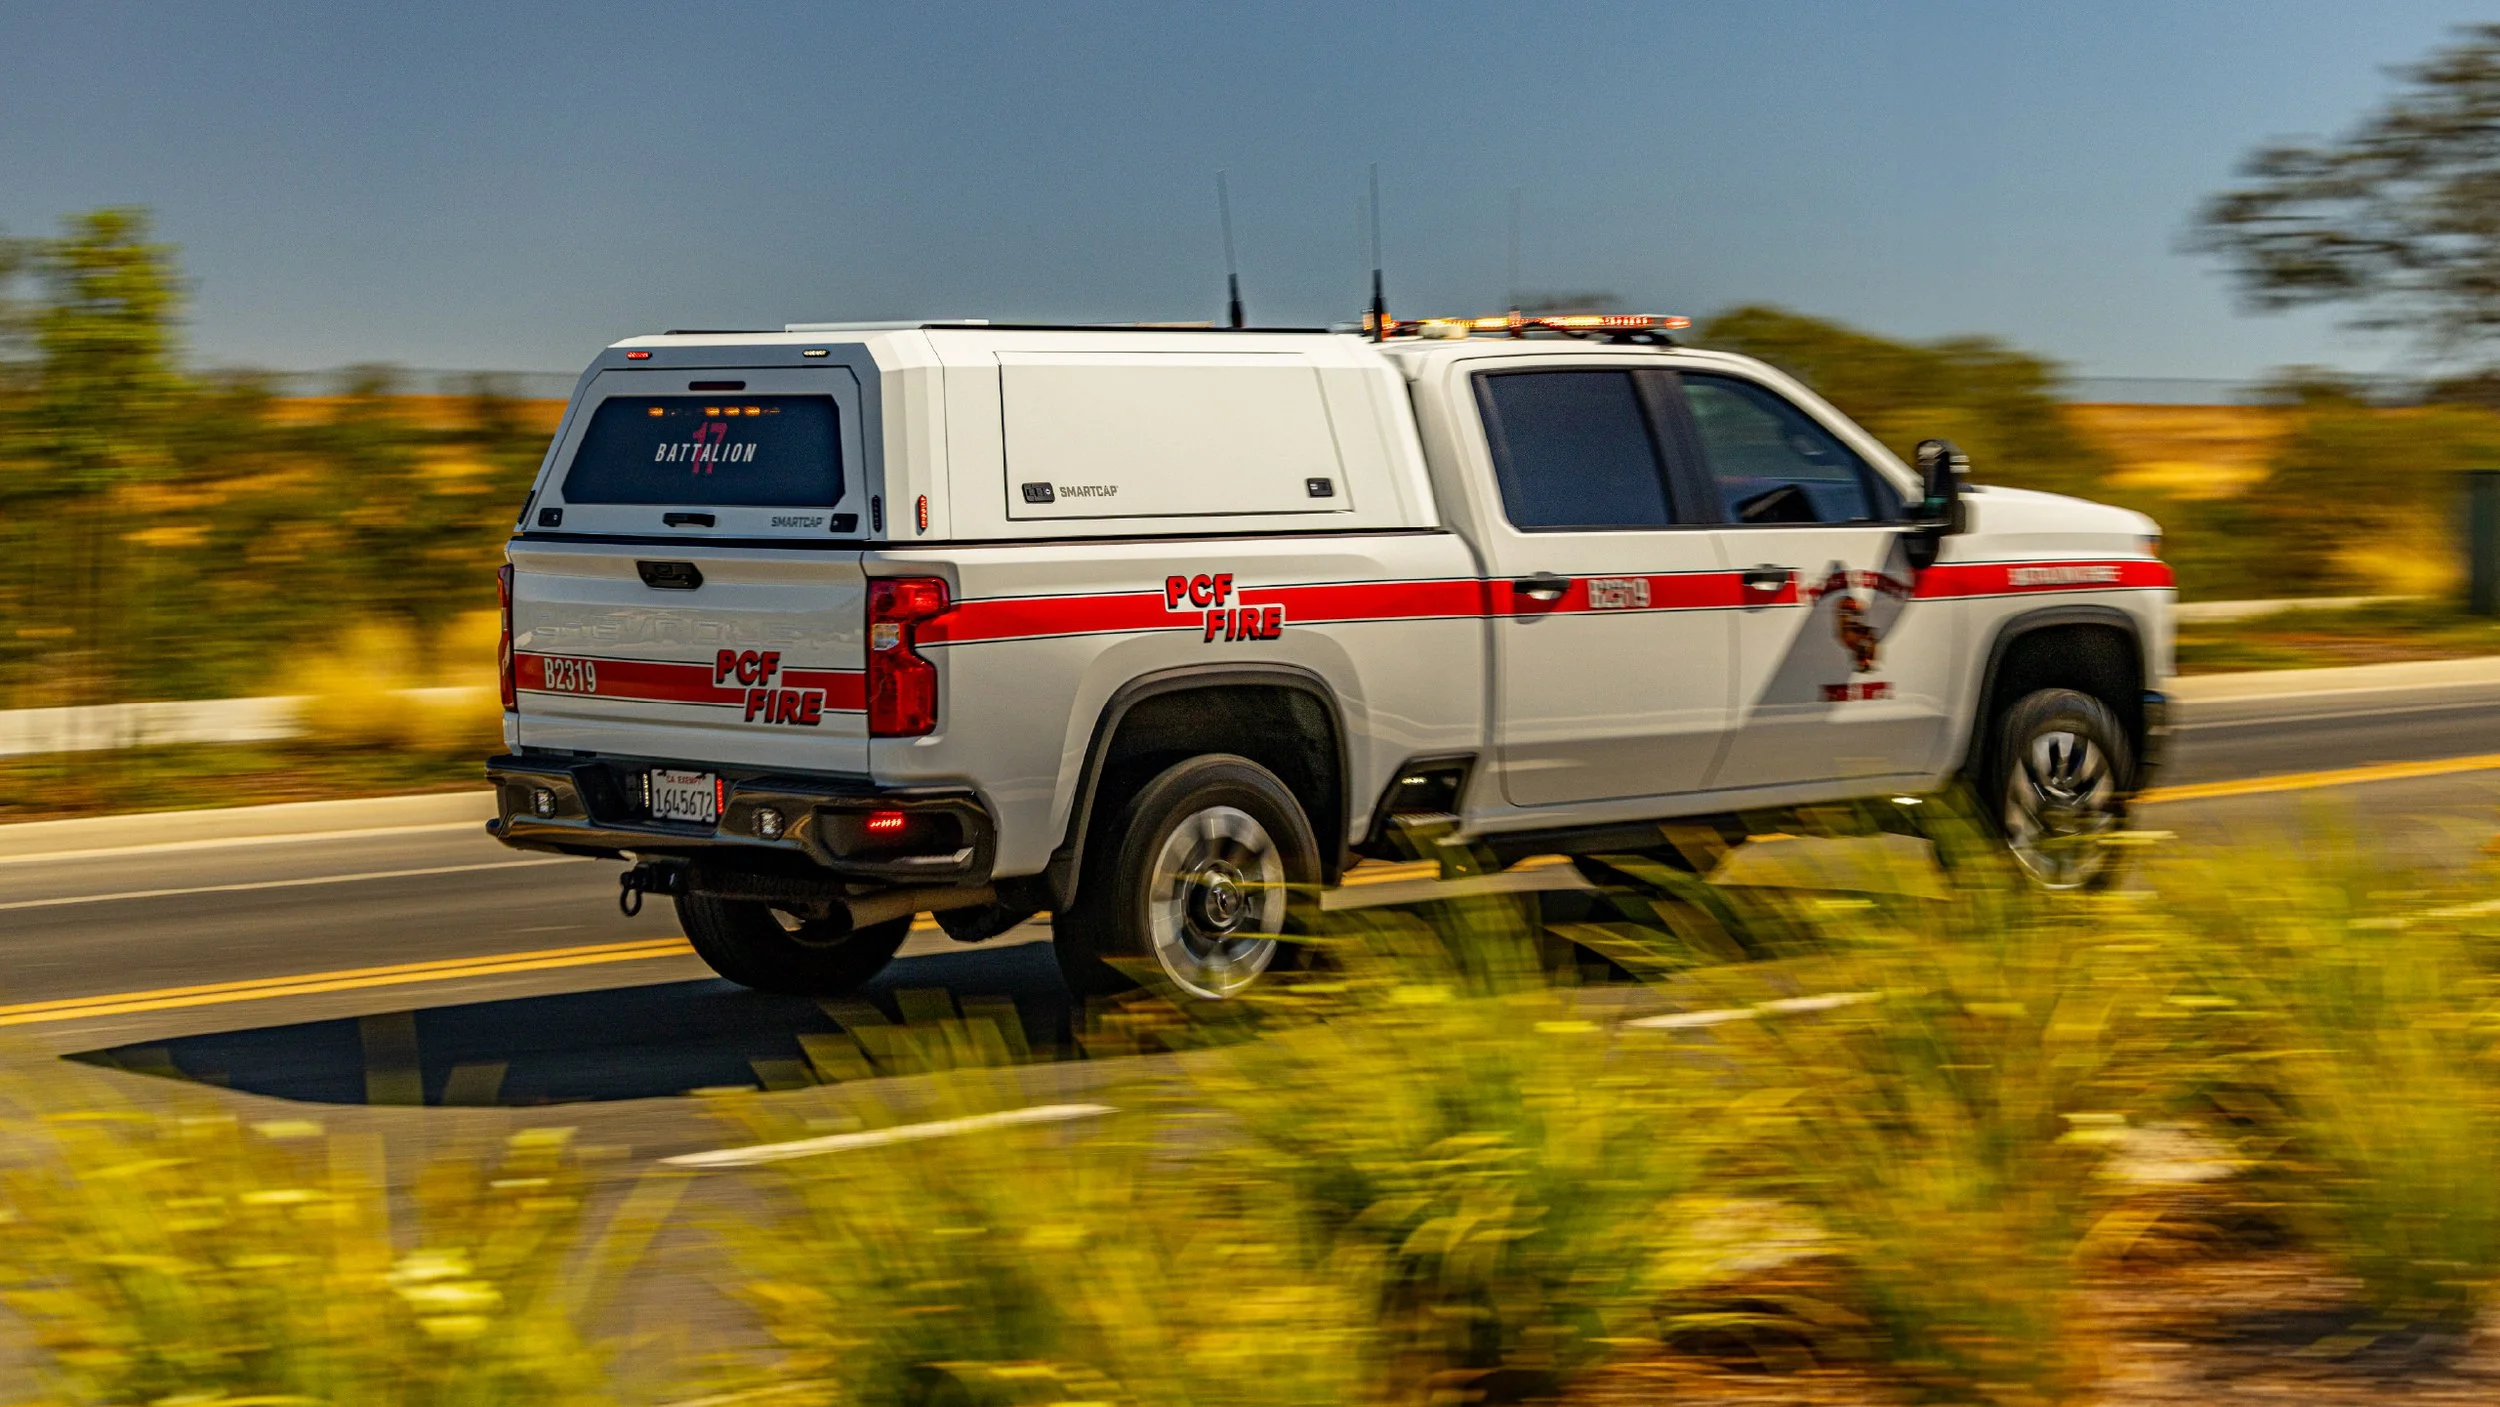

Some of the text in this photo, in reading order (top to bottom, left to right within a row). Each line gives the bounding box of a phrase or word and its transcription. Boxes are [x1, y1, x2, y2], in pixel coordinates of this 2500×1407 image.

[655, 443, 757, 462] BATTALION
[692, 421, 727, 474] 17
[1060, 486, 1117, 497] SMARTCAP
[771, 516, 823, 528] SMARTCAP
[1166, 573, 1233, 609] PCF
[1203, 607, 1282, 643] FIRE
[544, 657, 597, 693] B2319
[714, 649, 781, 686] PCF
[744, 689, 823, 725] FIRE
[656, 788, 712, 817] 1645672
